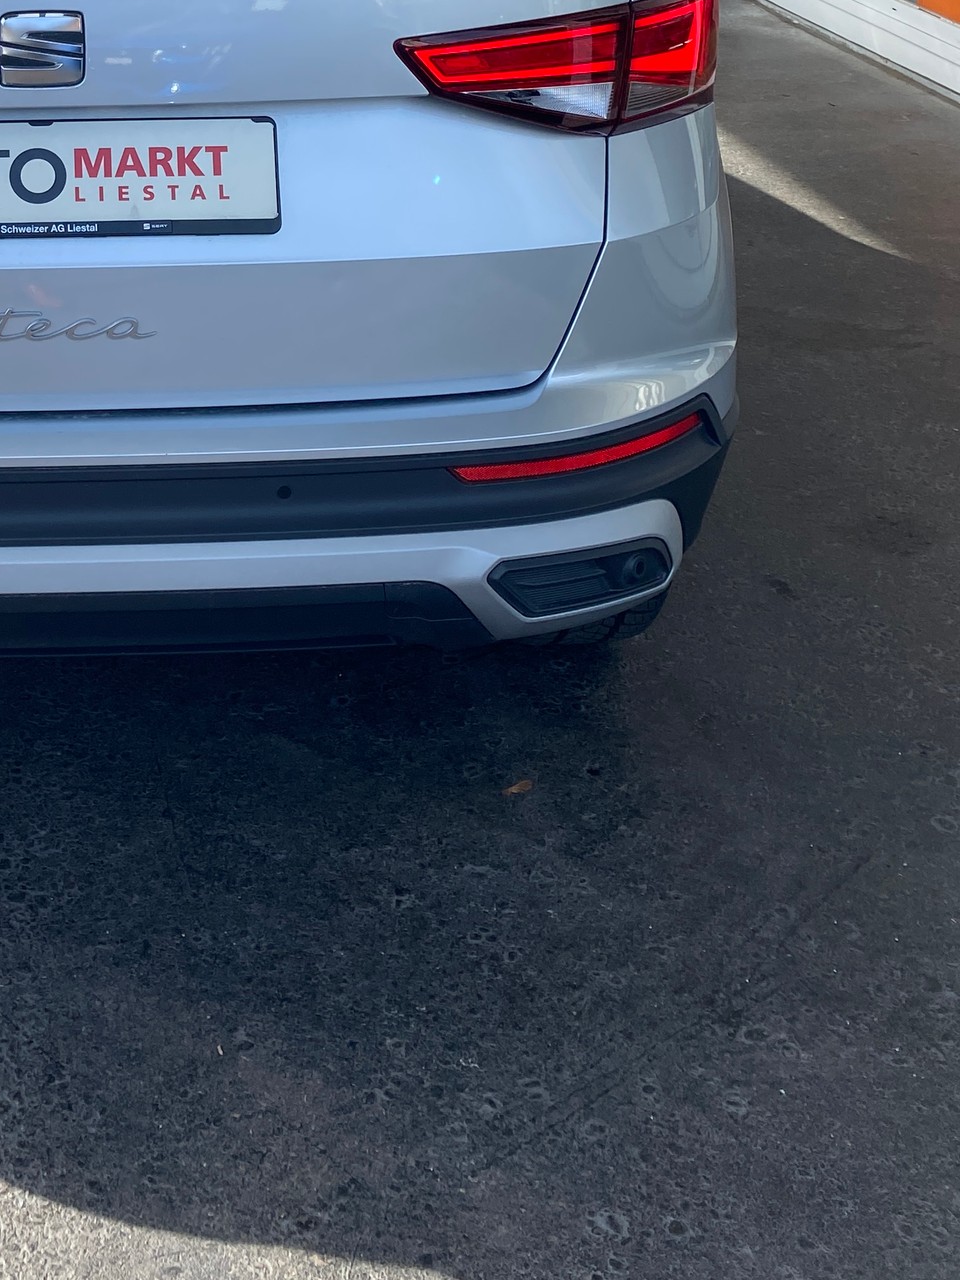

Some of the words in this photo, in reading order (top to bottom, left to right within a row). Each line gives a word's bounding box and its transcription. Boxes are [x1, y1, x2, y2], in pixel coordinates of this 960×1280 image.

[73, 145, 228, 178] MARKT
[74, 183, 230, 202] LIESTAL
[0, 224, 49, 234] Schweizer
[50, 224, 65, 233] AG
[67, 223, 98, 233] Liestal
